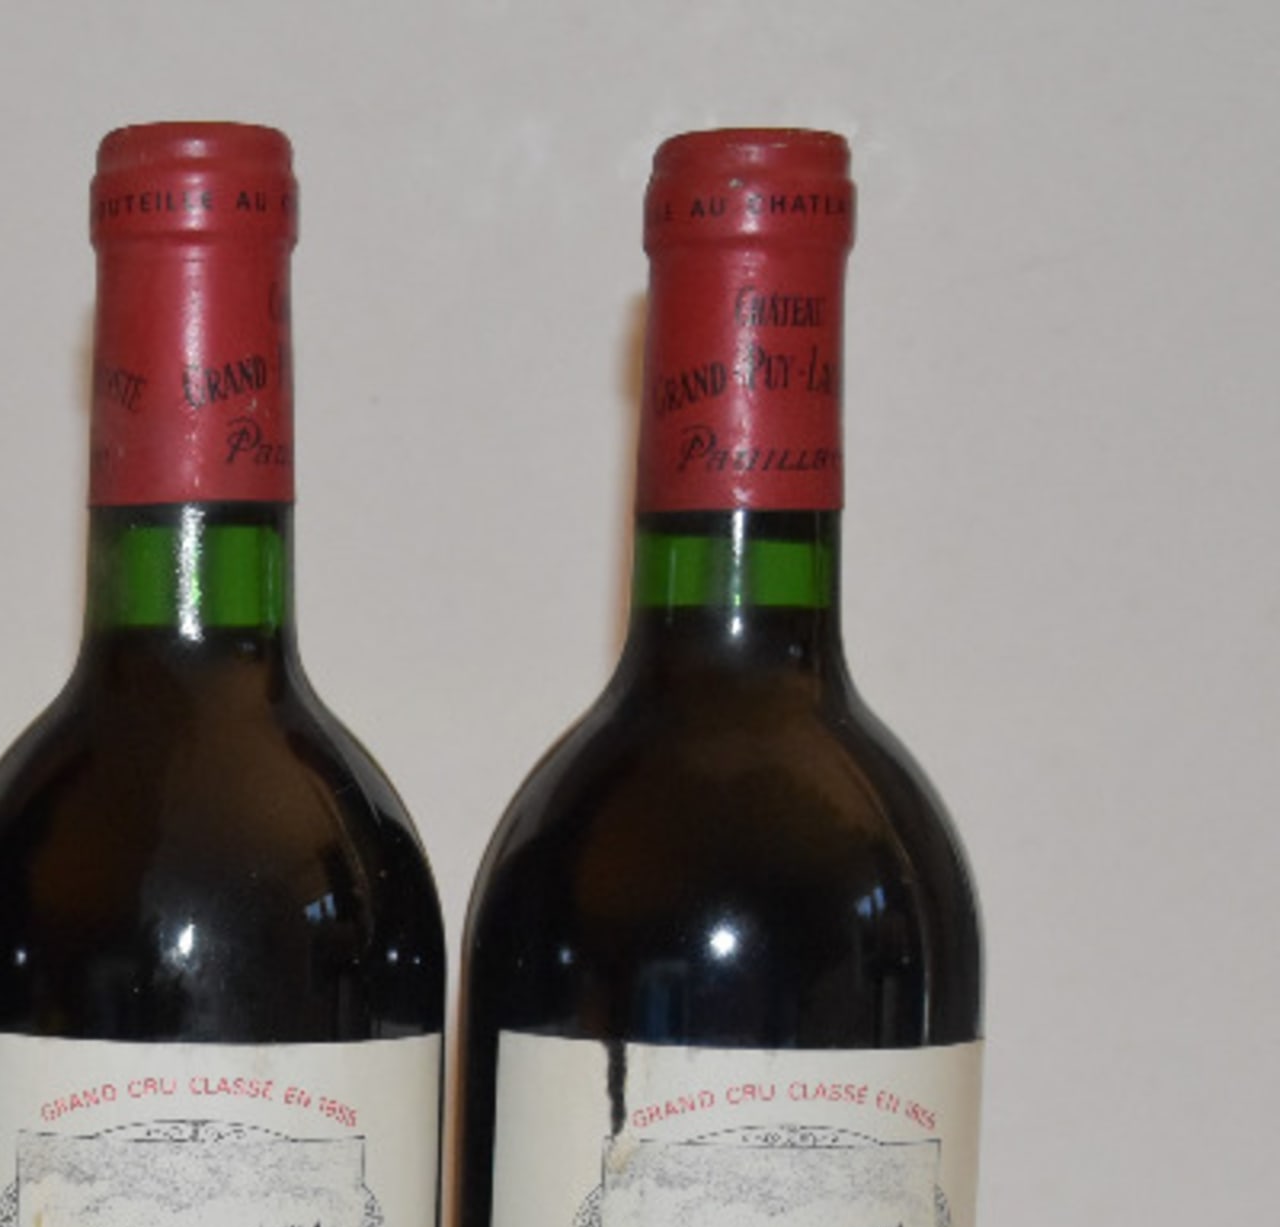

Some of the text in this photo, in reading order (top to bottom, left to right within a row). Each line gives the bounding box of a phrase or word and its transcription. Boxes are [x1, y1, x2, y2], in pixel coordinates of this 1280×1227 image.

[235, 190, 267, 213] AU
[690, 196, 726, 219] AU
[40, 1084, 117, 1122] GRAND
[127, 1077, 176, 1099] CRU
[283, 1086, 312, 1109] EN
[632, 1090, 715, 1128] GRAND
[726, 1083, 776, 1105] CRU
[875, 1090, 901, 1116] EN
